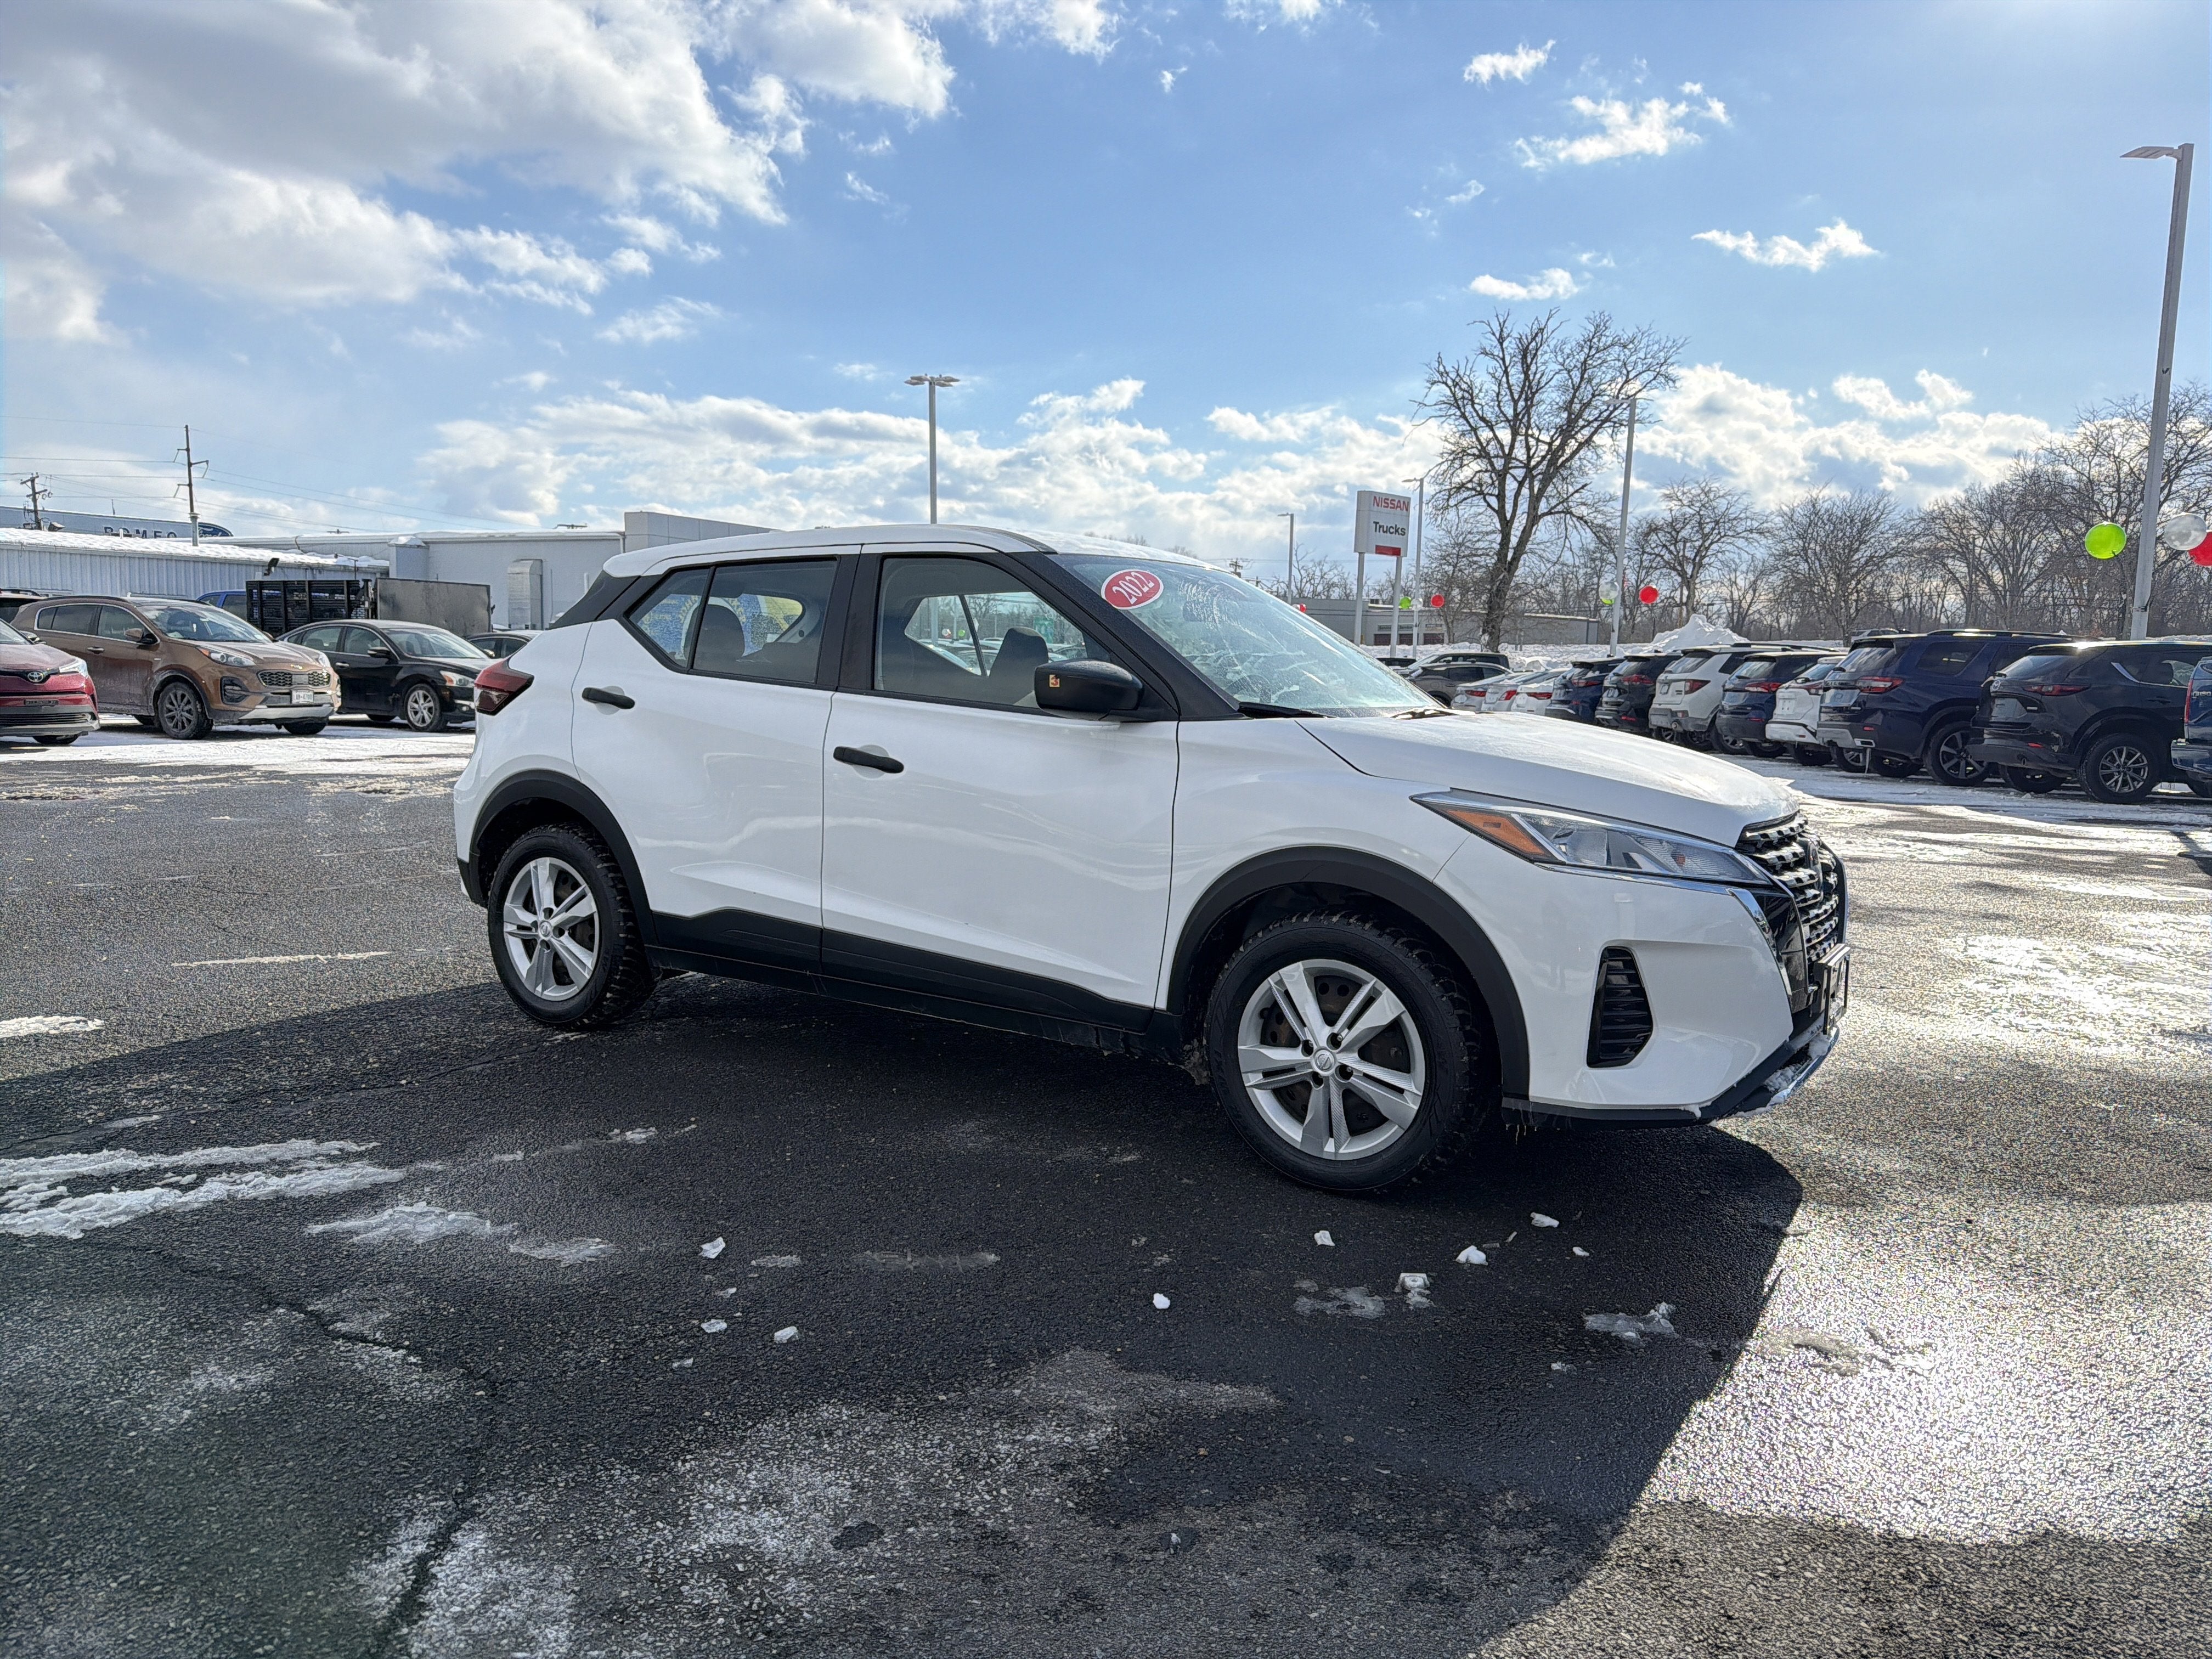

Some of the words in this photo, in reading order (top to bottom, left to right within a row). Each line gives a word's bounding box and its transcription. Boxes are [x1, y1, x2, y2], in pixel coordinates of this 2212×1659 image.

[1373, 496, 1409, 512] NISSAN
[1373, 521, 1406, 536] Trucks
[1112, 572, 1155, 605] 2022
[1051, 675, 1059, 686] 3
